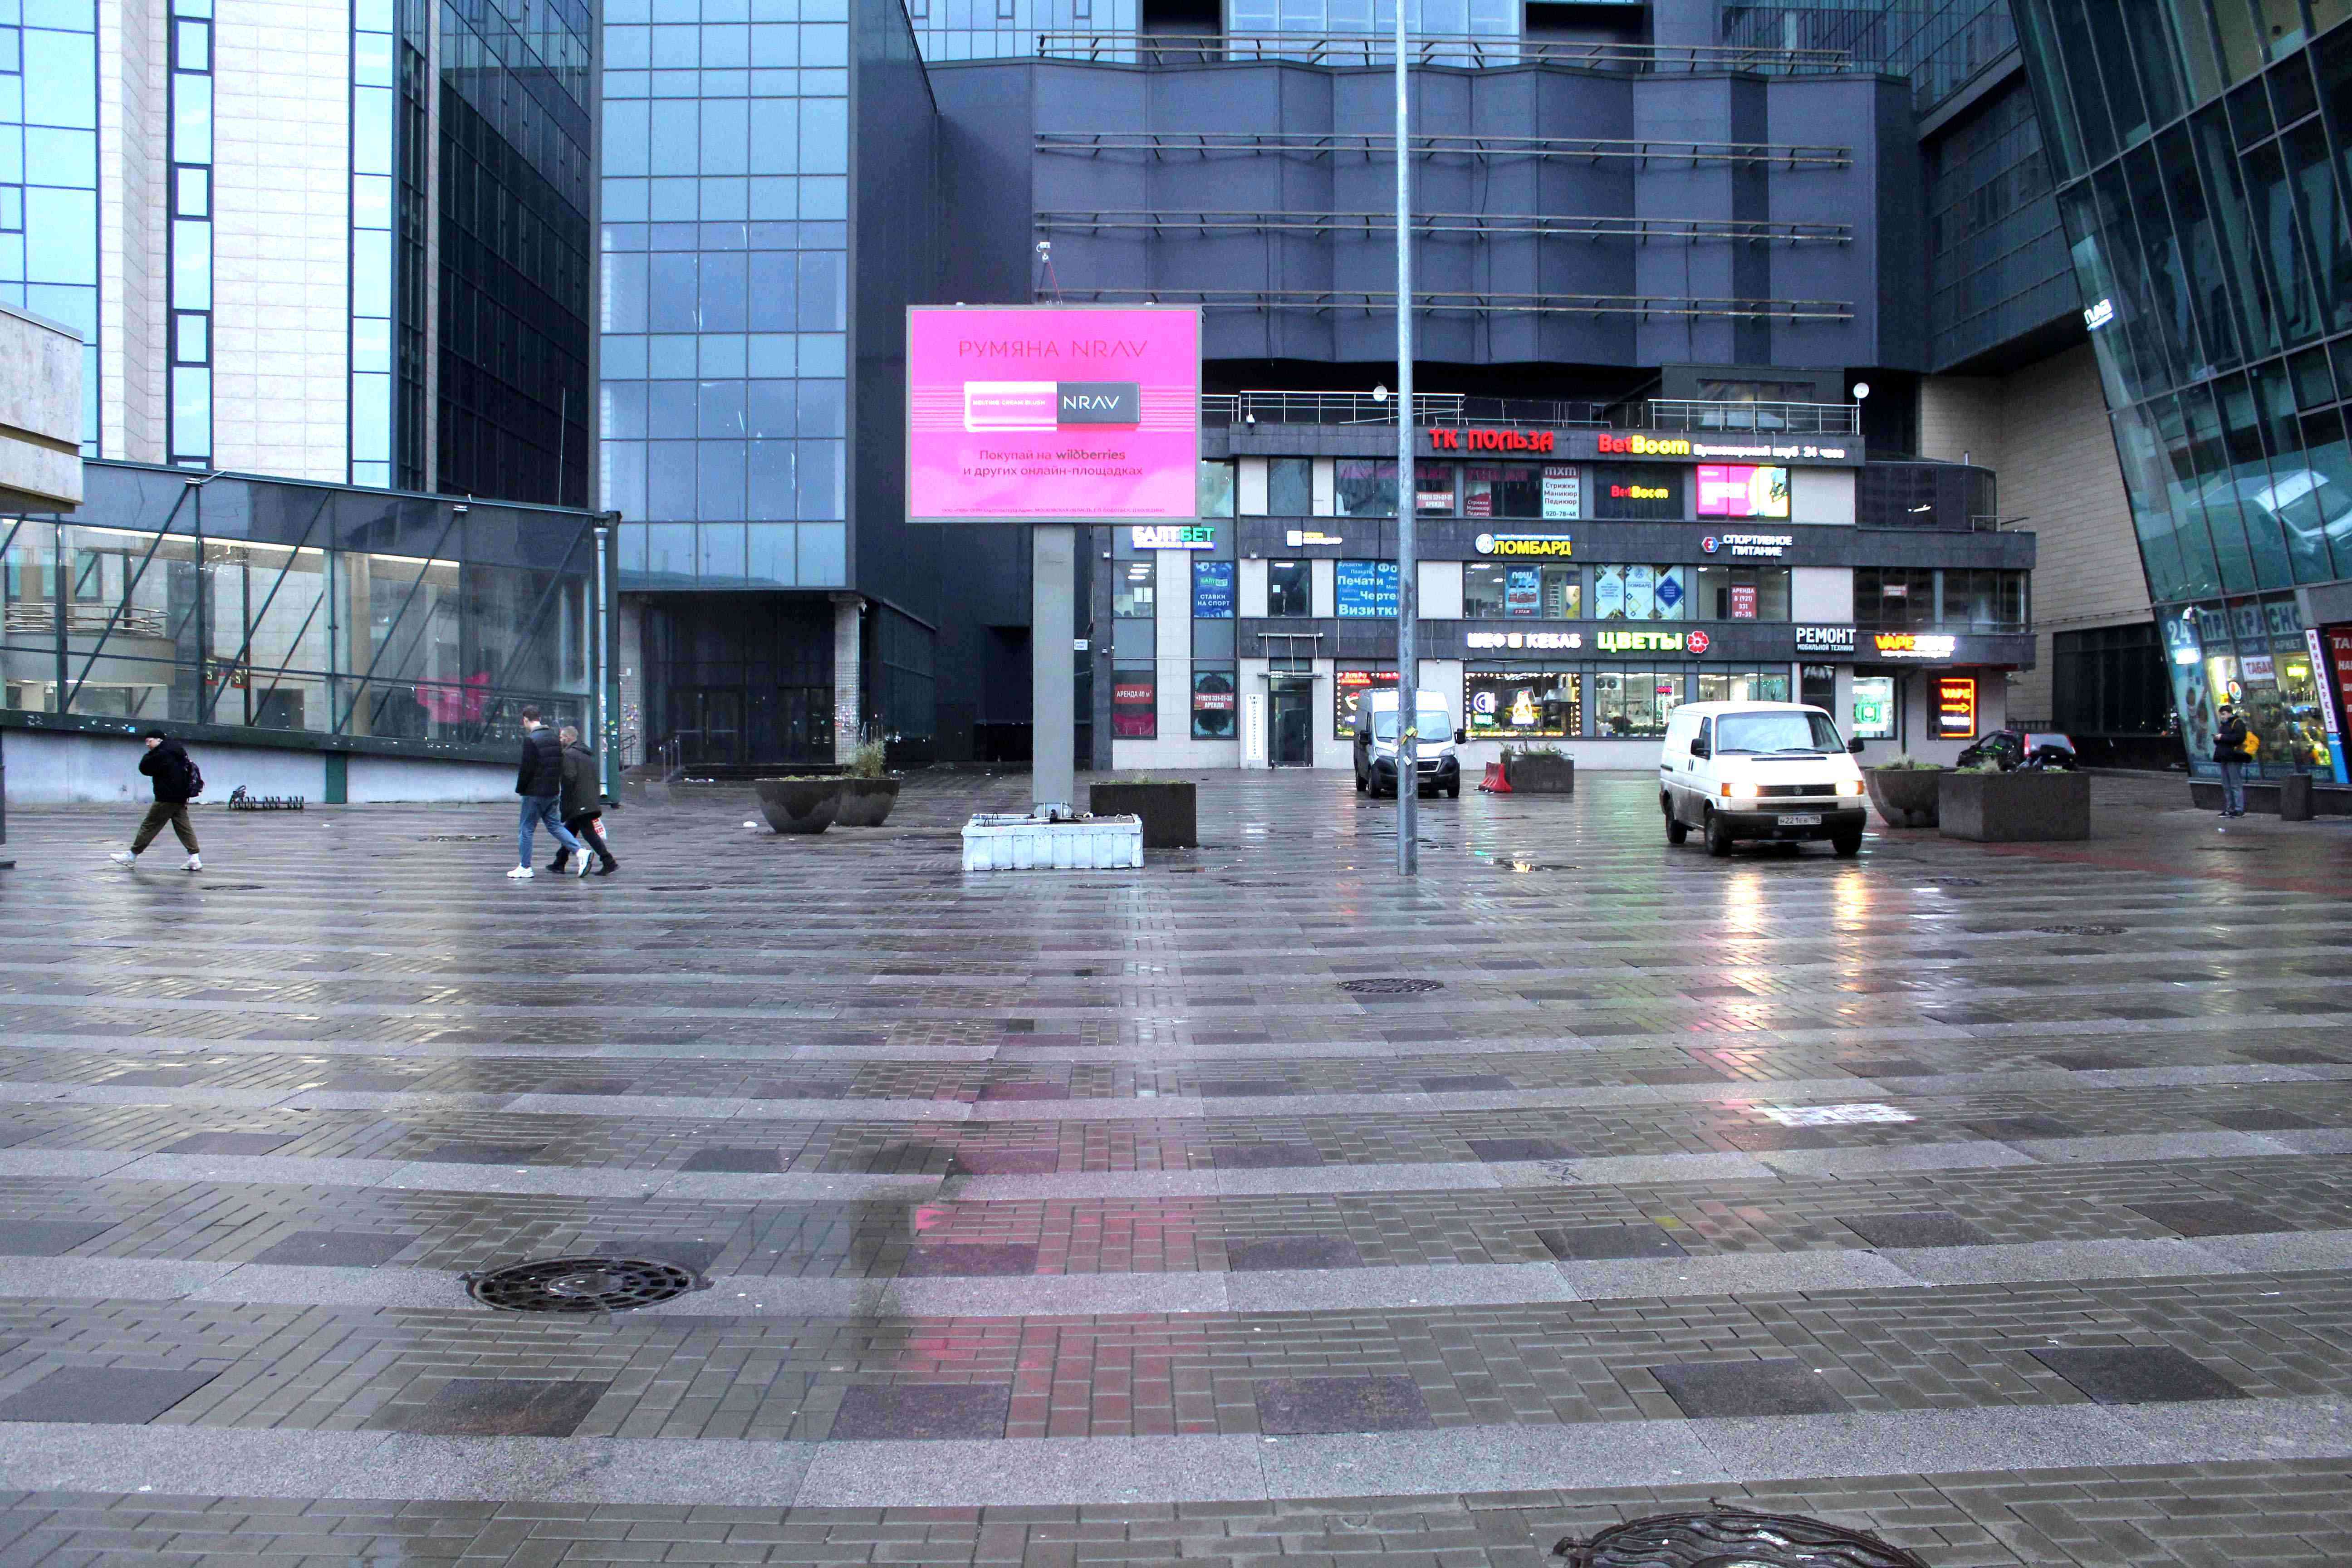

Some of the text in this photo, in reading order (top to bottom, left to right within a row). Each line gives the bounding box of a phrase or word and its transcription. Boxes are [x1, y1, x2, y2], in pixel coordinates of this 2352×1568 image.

[959, 340, 1148, 357] РУМЯНА NRAV
[1063, 396, 1120, 409] NRAV
[1430, 429, 1554, 452] ТК ПОЛЬЗА
[1598, 434, 1690, 455] BetBoom
[979, 450, 1033, 462] Покупай
[1056, 450, 1126, 460] wildberries
[974, 467, 1017, 478] других
[1020, 466, 1143, 477] онлайн-площадках
[1132, 526, 1215, 542] БАЛТБЕТ
[1723, 534, 1792, 546] СПОРТИВНОЕ
[1493, 540, 1572, 556] ЛОМБАРД
[1732, 545, 1783, 557] ПИТАНИЕ
[1338, 576, 1383, 585] Печати
[1796, 627, 1857, 644] РЕМОНТ
[2167, 618, 2193, 645] 24
[1527, 632, 1582, 649] КЕБАБ
[1597, 631, 1683, 653] ЦВЕТЫ
[1940, 688, 1971, 699] VAPE
